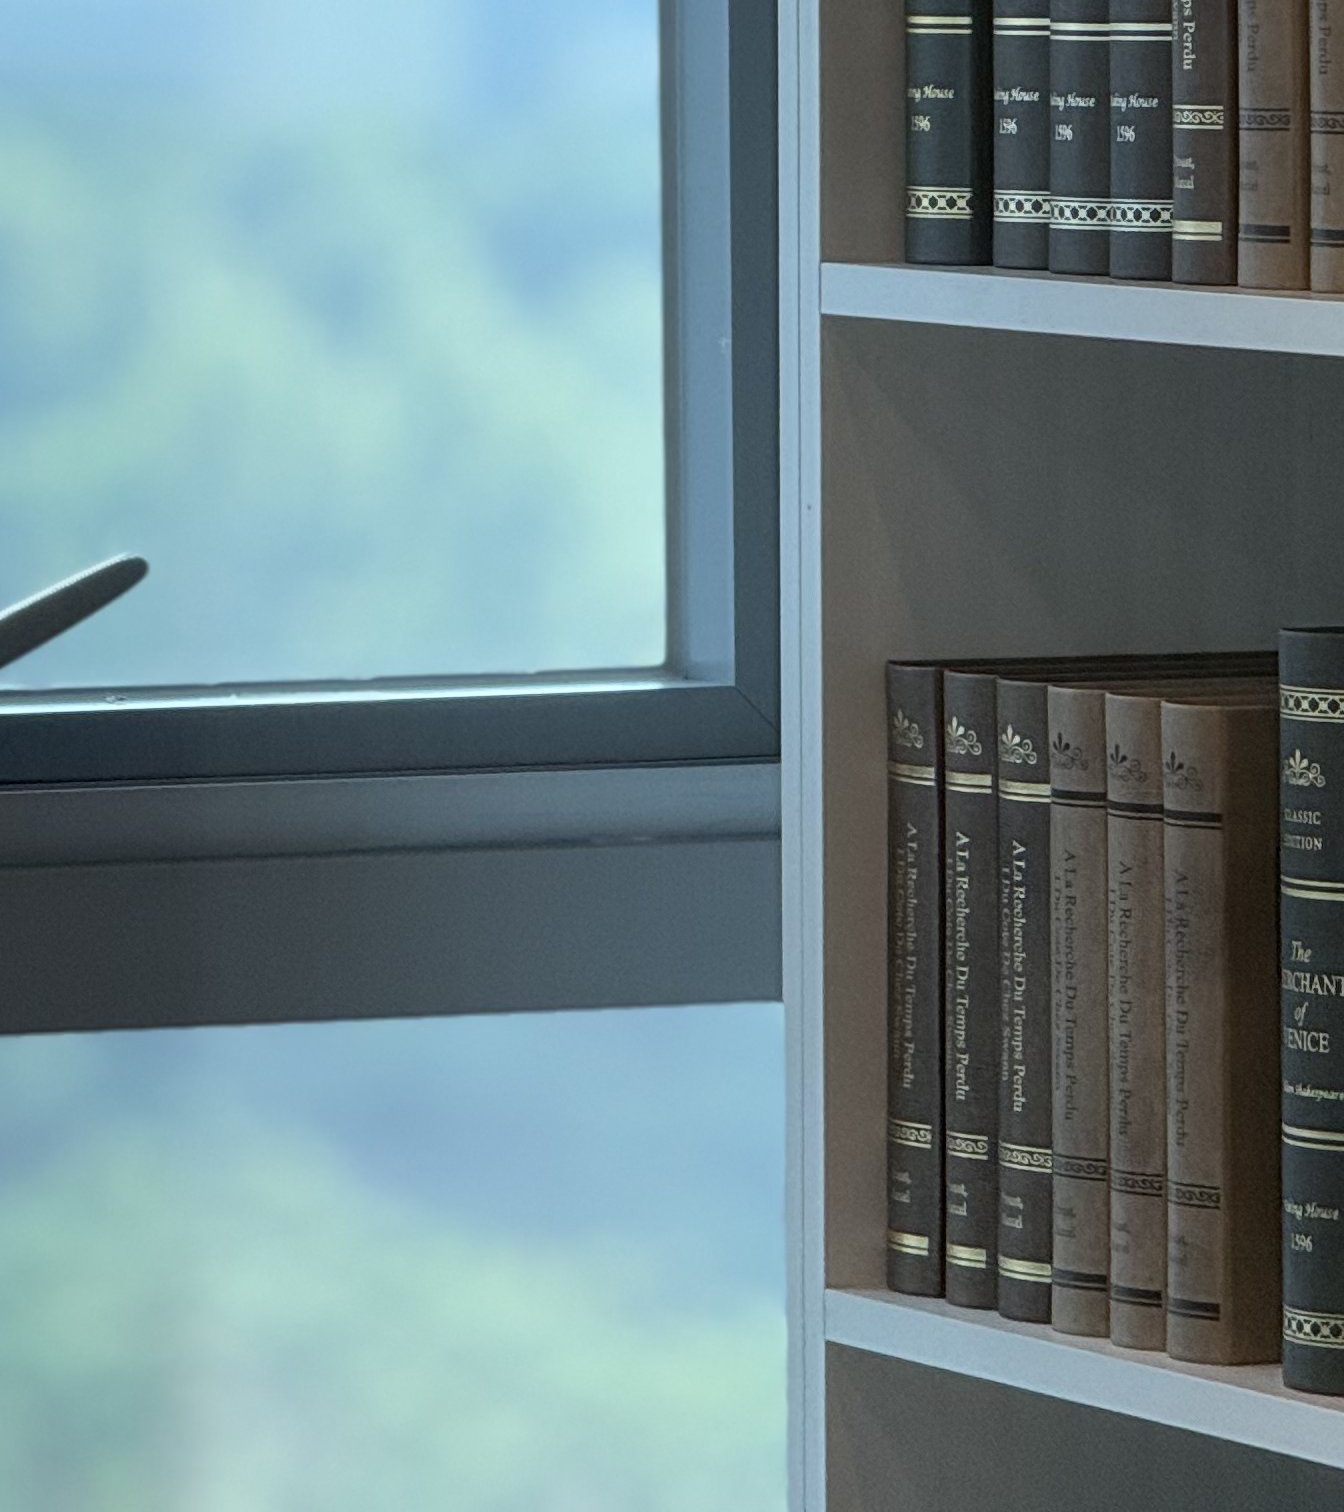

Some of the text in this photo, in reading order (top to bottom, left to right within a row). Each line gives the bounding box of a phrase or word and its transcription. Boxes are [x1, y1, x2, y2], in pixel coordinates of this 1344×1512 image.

[1183, 22, 1196, 70] Perdu
[923, 84, 954, 99] House
[1011, 87, 1039, 102] House
[1067, 92, 1095, 107] House
[1129, 92, 1158, 108] House
[911, 116, 930, 131] 1596
[999, 118, 1017, 134] 1596
[1055, 125, 1073, 141] 1596
[1117, 125, 1135, 142] 1596
[956, 831, 970, 847] A
[1013, 840, 1026, 856] A
[956, 876, 970, 961] Recherche
[1013, 886, 1026, 972] Recherche
[956, 966, 969, 989] Du
[1014, 977, 1026, 1000] Du
[954, 995, 969, 1048] Temps
[1012, 1006, 1026, 1059] Temps
[956, 1053, 970, 1100] Perdu
[1014, 1066, 1026, 1112] Perdu
